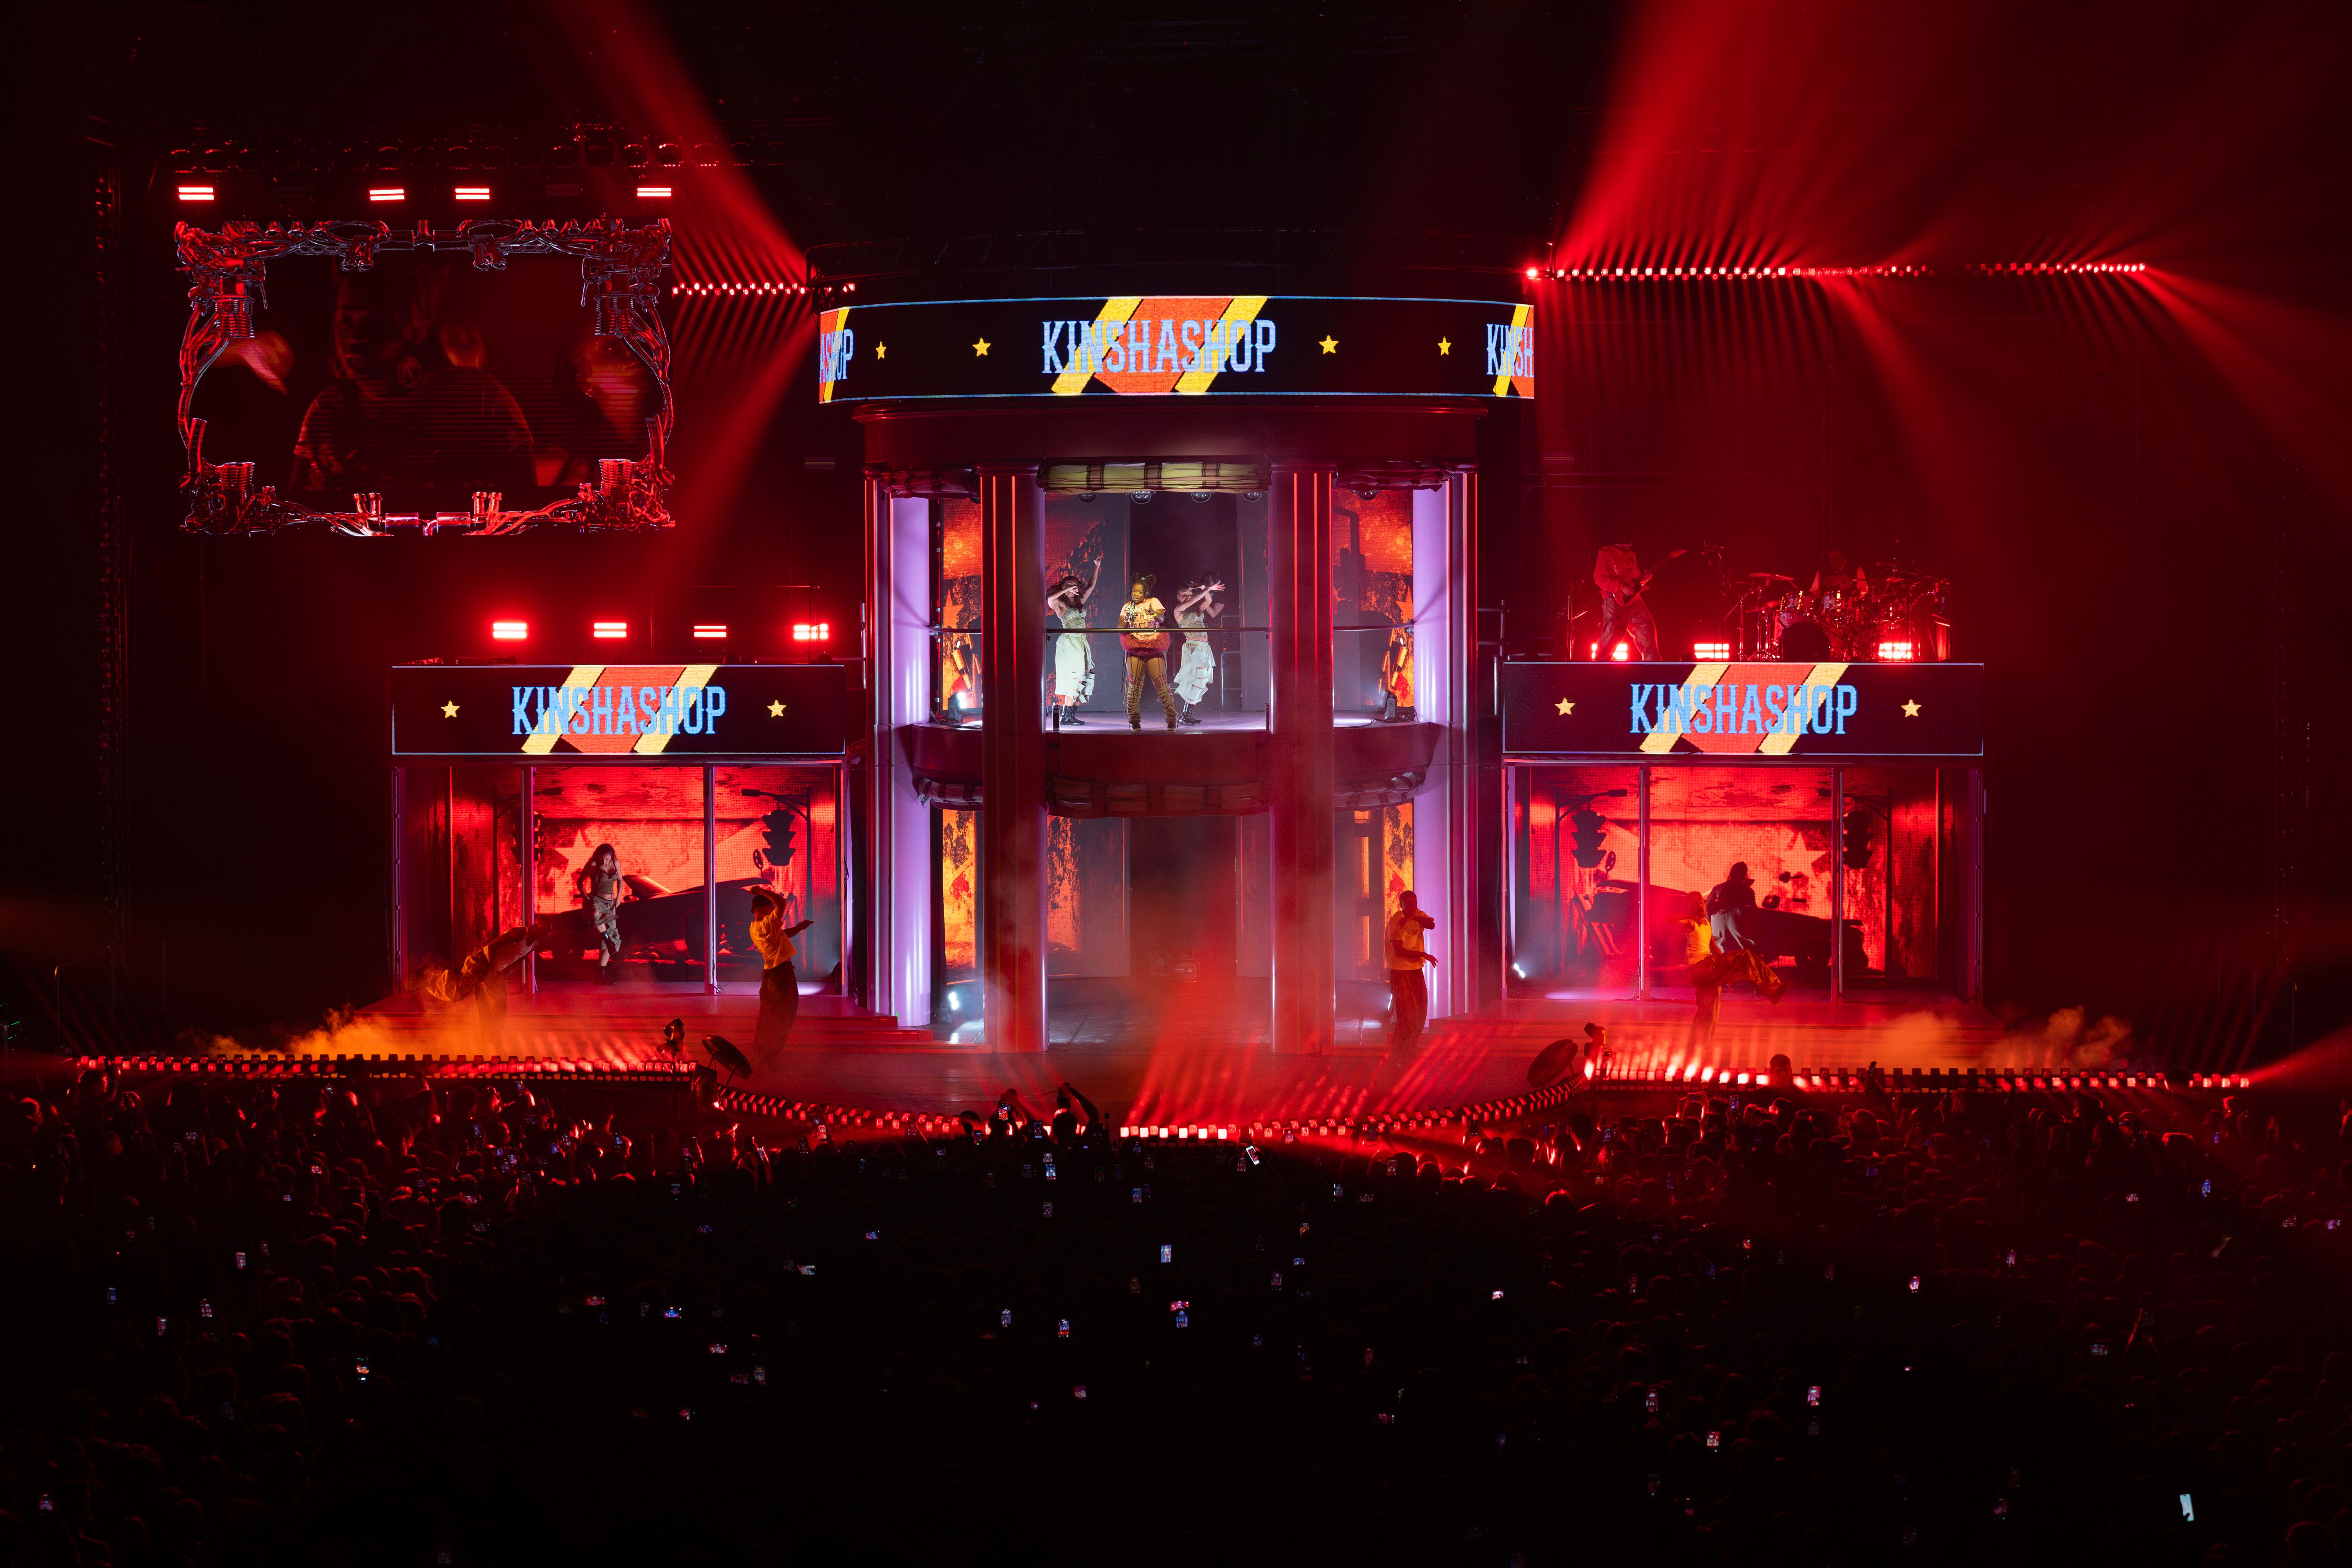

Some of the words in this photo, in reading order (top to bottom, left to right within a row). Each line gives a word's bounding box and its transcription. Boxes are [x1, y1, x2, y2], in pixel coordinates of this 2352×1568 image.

[1042, 319, 1276, 373] KINSHASHOP
[1486, 324, 1534, 377] KINSH
[512, 686, 726, 734] KINSHASHOP
[1630, 684, 1857, 734] KINSHASHOP
